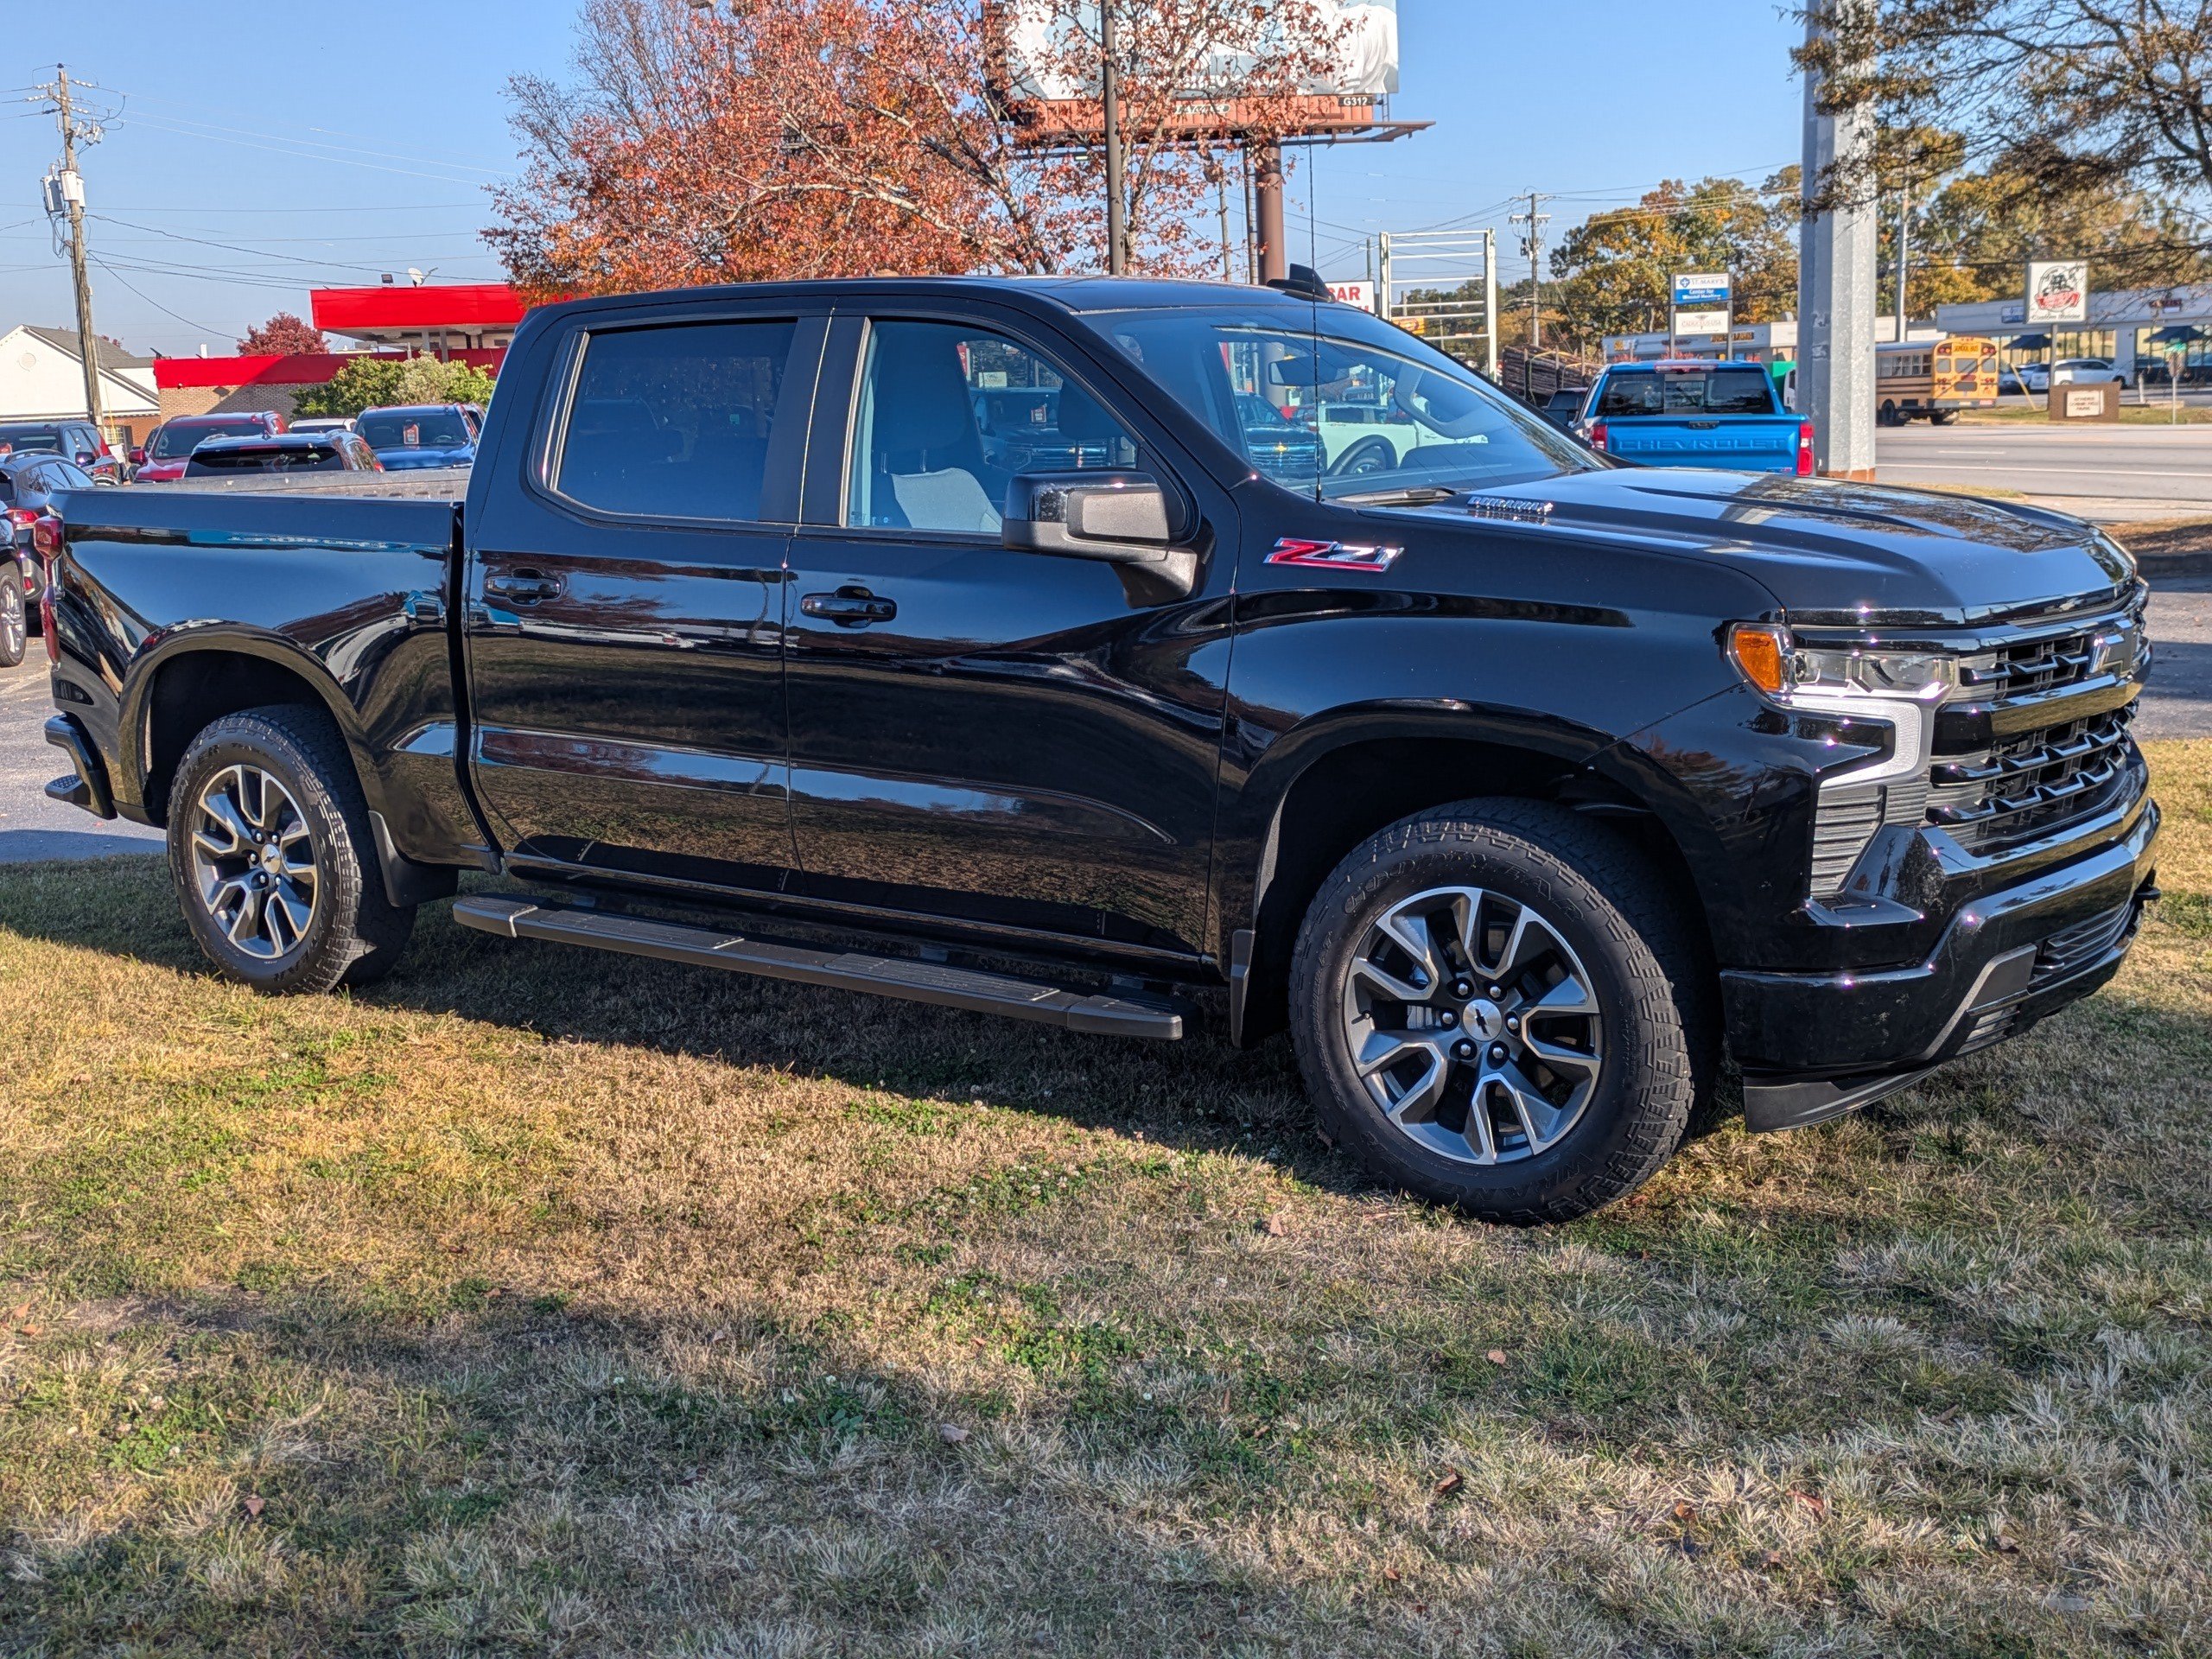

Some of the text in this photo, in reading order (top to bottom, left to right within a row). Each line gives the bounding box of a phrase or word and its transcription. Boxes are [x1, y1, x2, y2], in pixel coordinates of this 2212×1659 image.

[1343, 97, 1368, 106] G312
[1618, 438, 1789, 450] CHEVROLET
[1263, 537, 1405, 573] Z71
